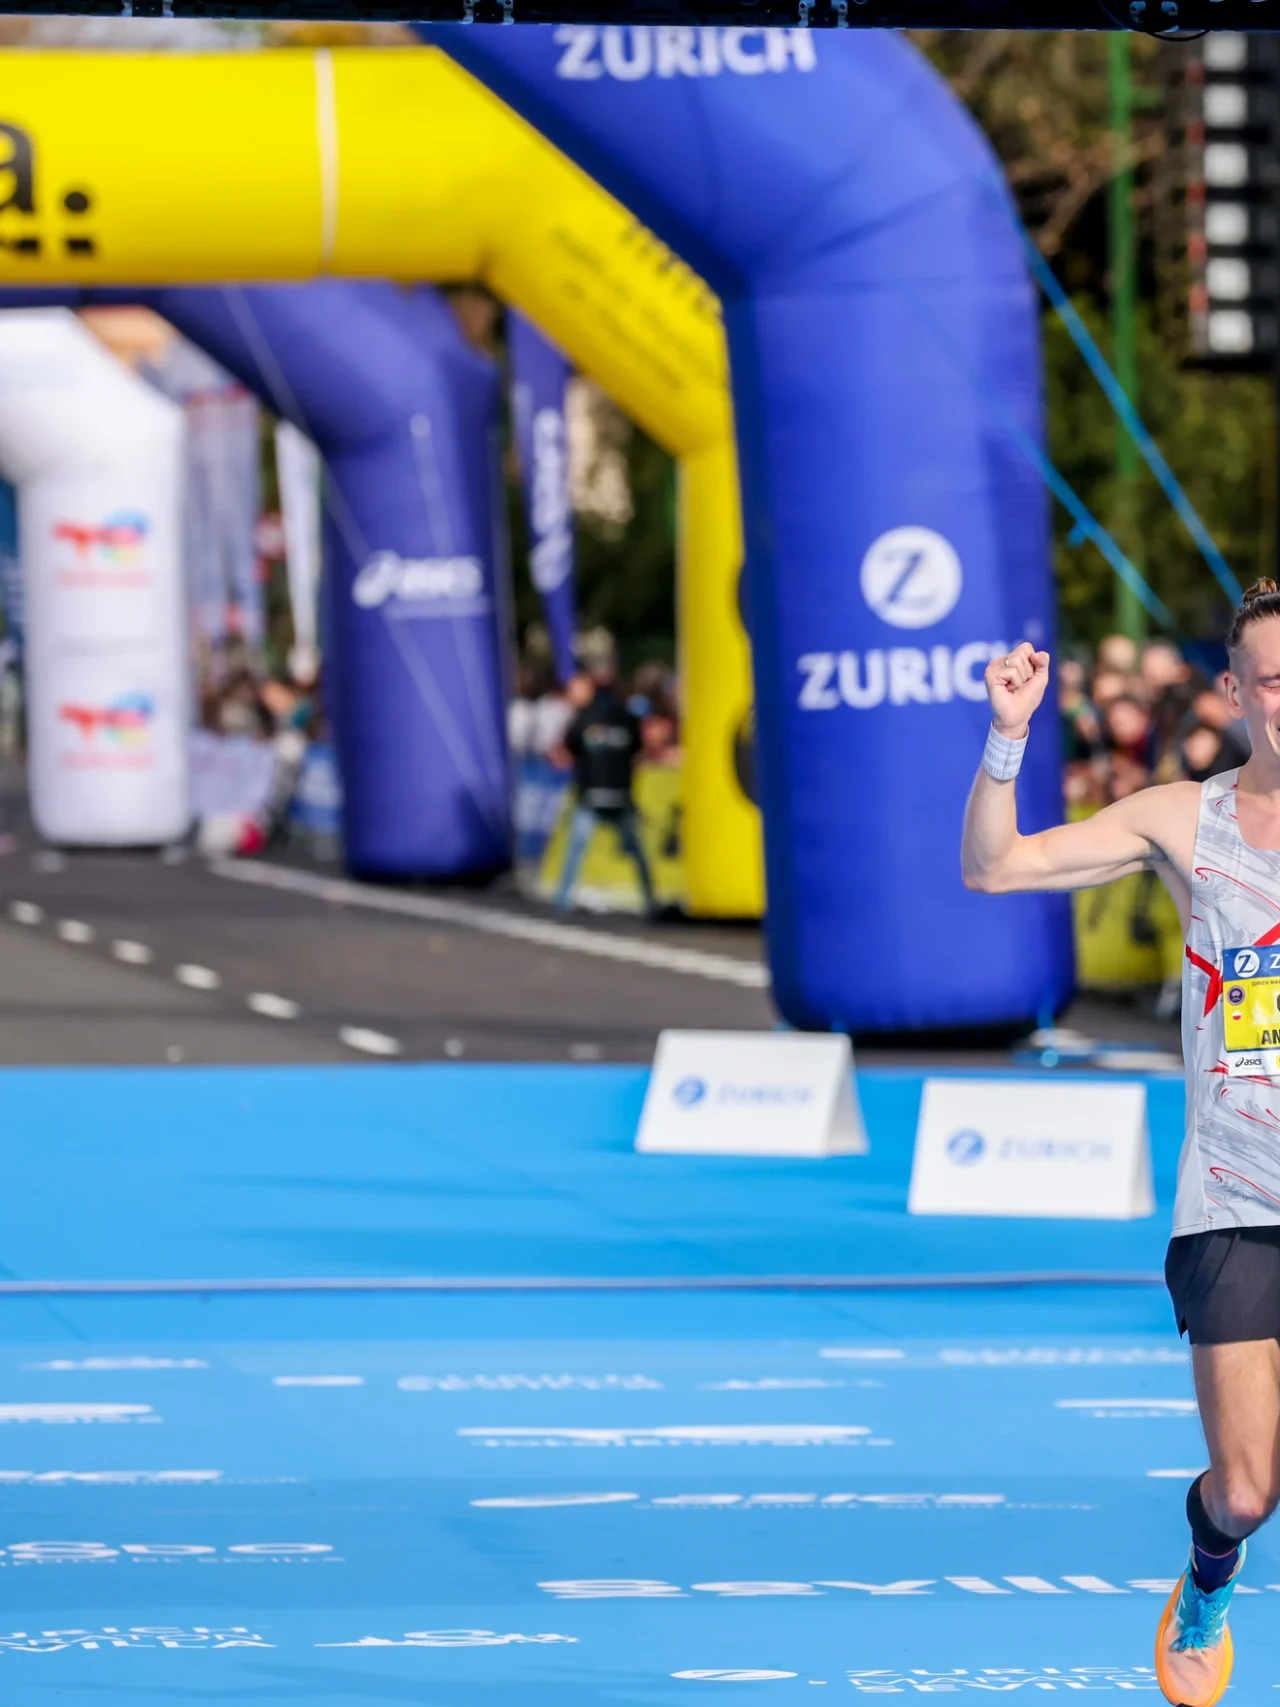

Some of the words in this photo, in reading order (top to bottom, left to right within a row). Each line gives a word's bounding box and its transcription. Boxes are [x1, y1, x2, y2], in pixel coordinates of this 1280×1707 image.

[553, 25, 817, 80] ZURICH
[797, 641, 1008, 711] ZURIC
[1244, 1058, 1262, 1067] asics
[845, 1666, 1157, 1678] ZURIC
[848, 1674, 1157, 1686] MARATÓ
[856, 1682, 1160, 1693] SEVILL
